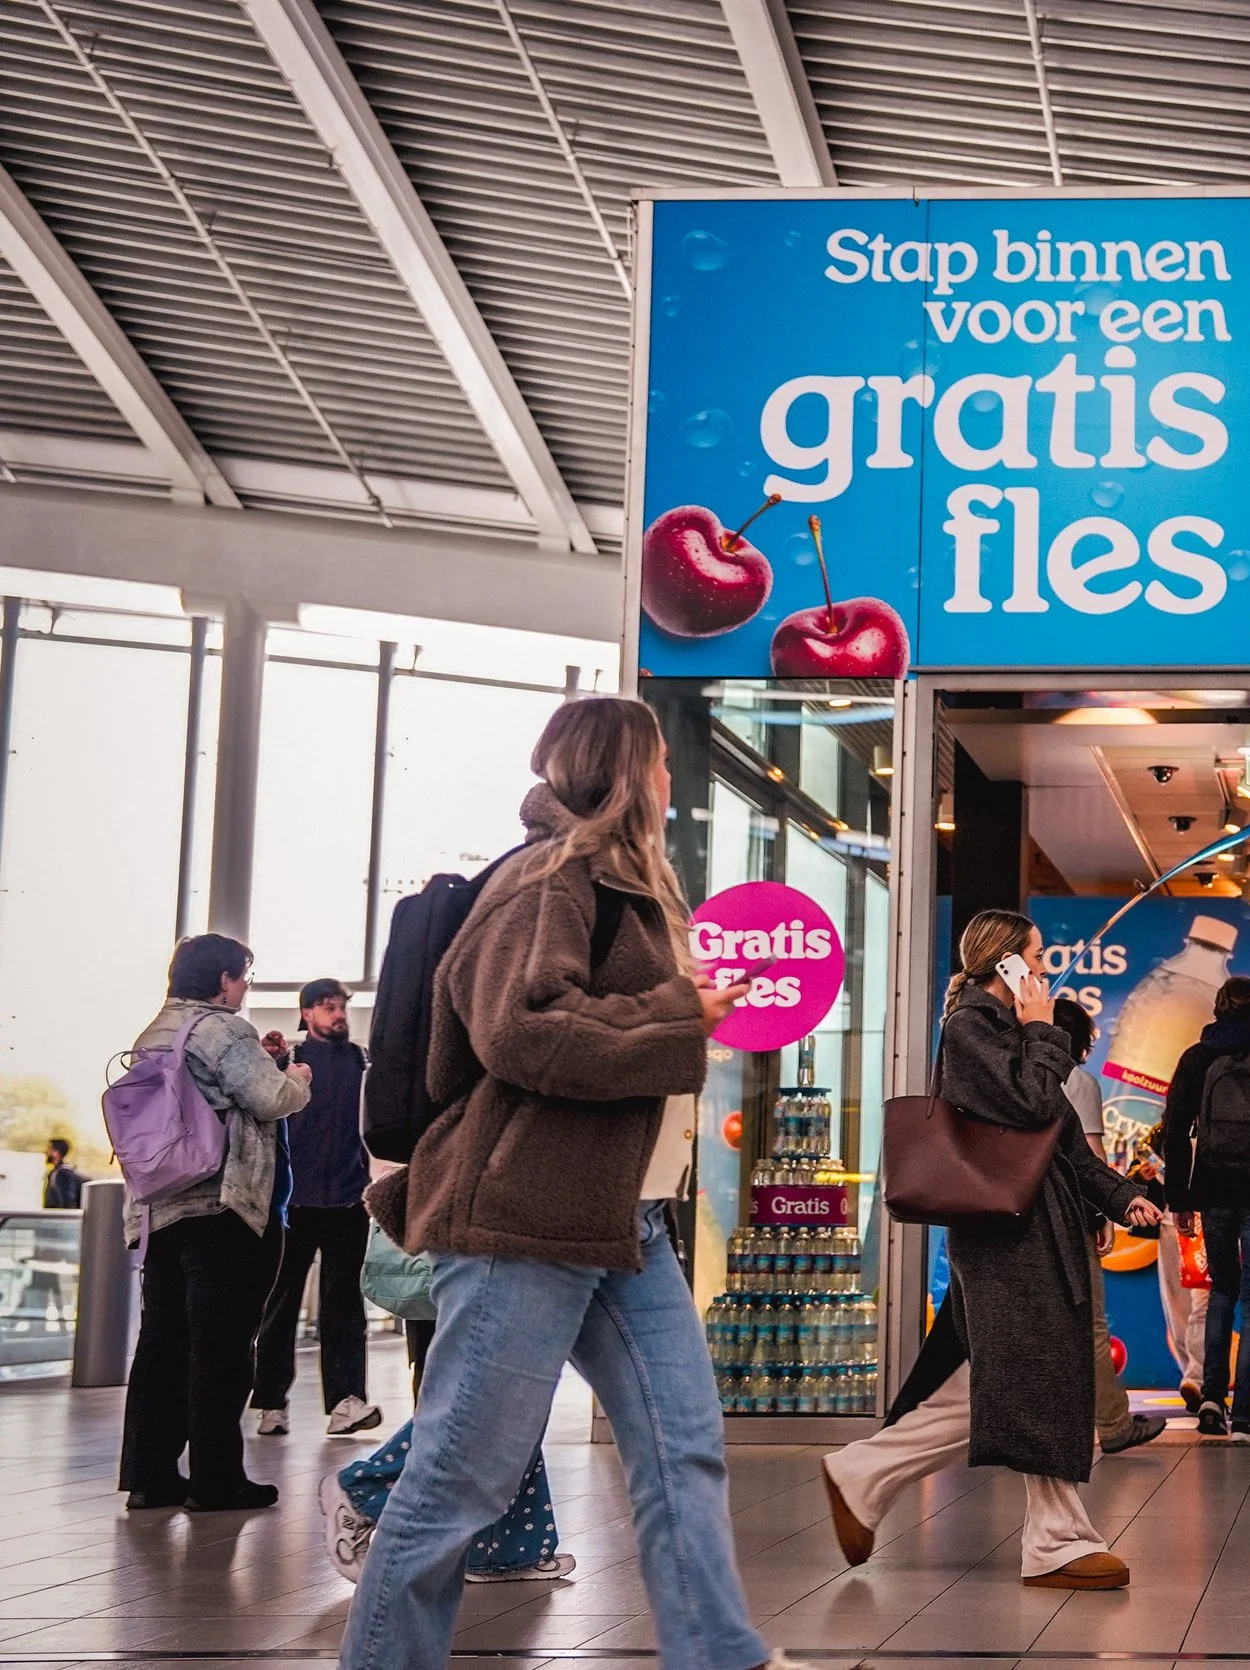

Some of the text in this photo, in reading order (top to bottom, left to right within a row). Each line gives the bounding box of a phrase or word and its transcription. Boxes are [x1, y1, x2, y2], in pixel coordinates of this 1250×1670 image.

[825, 228, 1232, 295] Stap binnen
[923, 300, 1232, 344] voor een
[760, 344, 1229, 503] gratis
[942, 483, 1227, 615] fles
[689, 920, 831, 960] Gratis
[1103, 1106, 1152, 1140] Crys
[771, 1196, 829, 1215] Gratis
